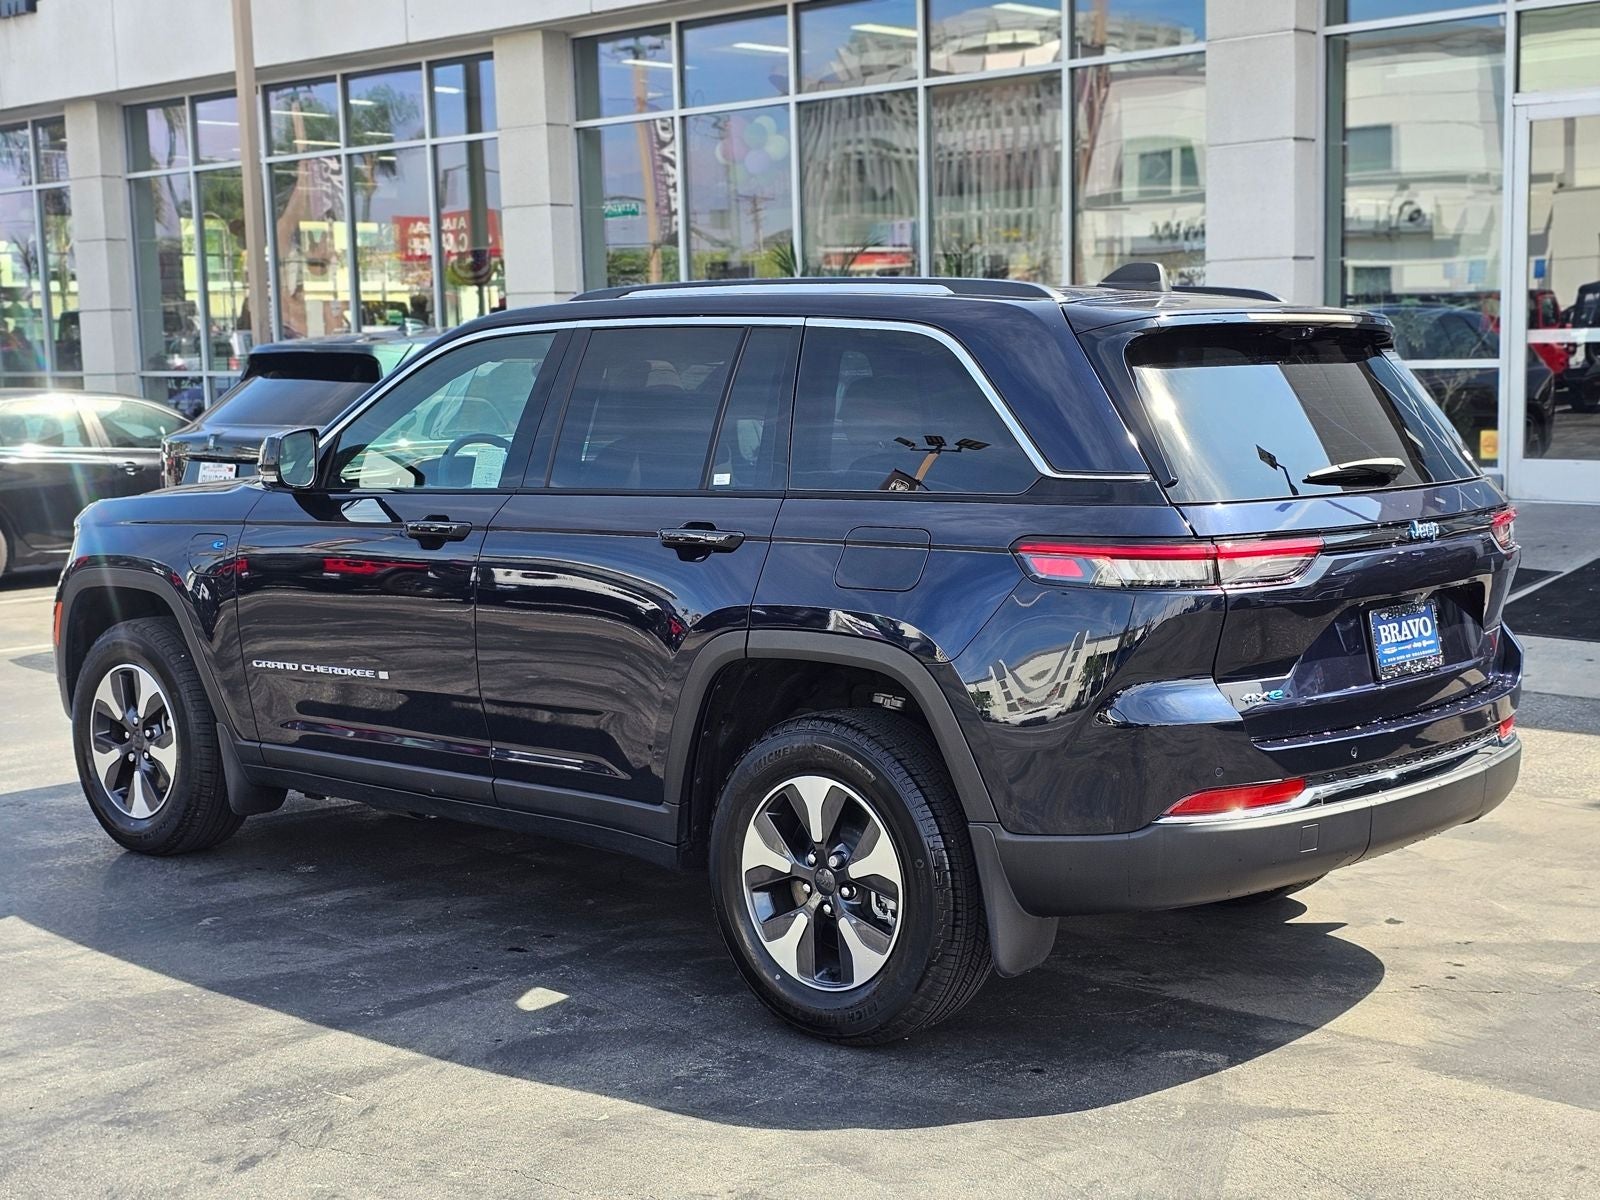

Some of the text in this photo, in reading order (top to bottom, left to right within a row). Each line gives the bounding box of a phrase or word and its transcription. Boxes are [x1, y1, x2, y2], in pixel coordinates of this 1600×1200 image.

[1410, 520, 1439, 540] Jeep
[1378, 616, 1432, 645] BRAVO
[252, 659, 376, 678] GRAND CHEROKEE
